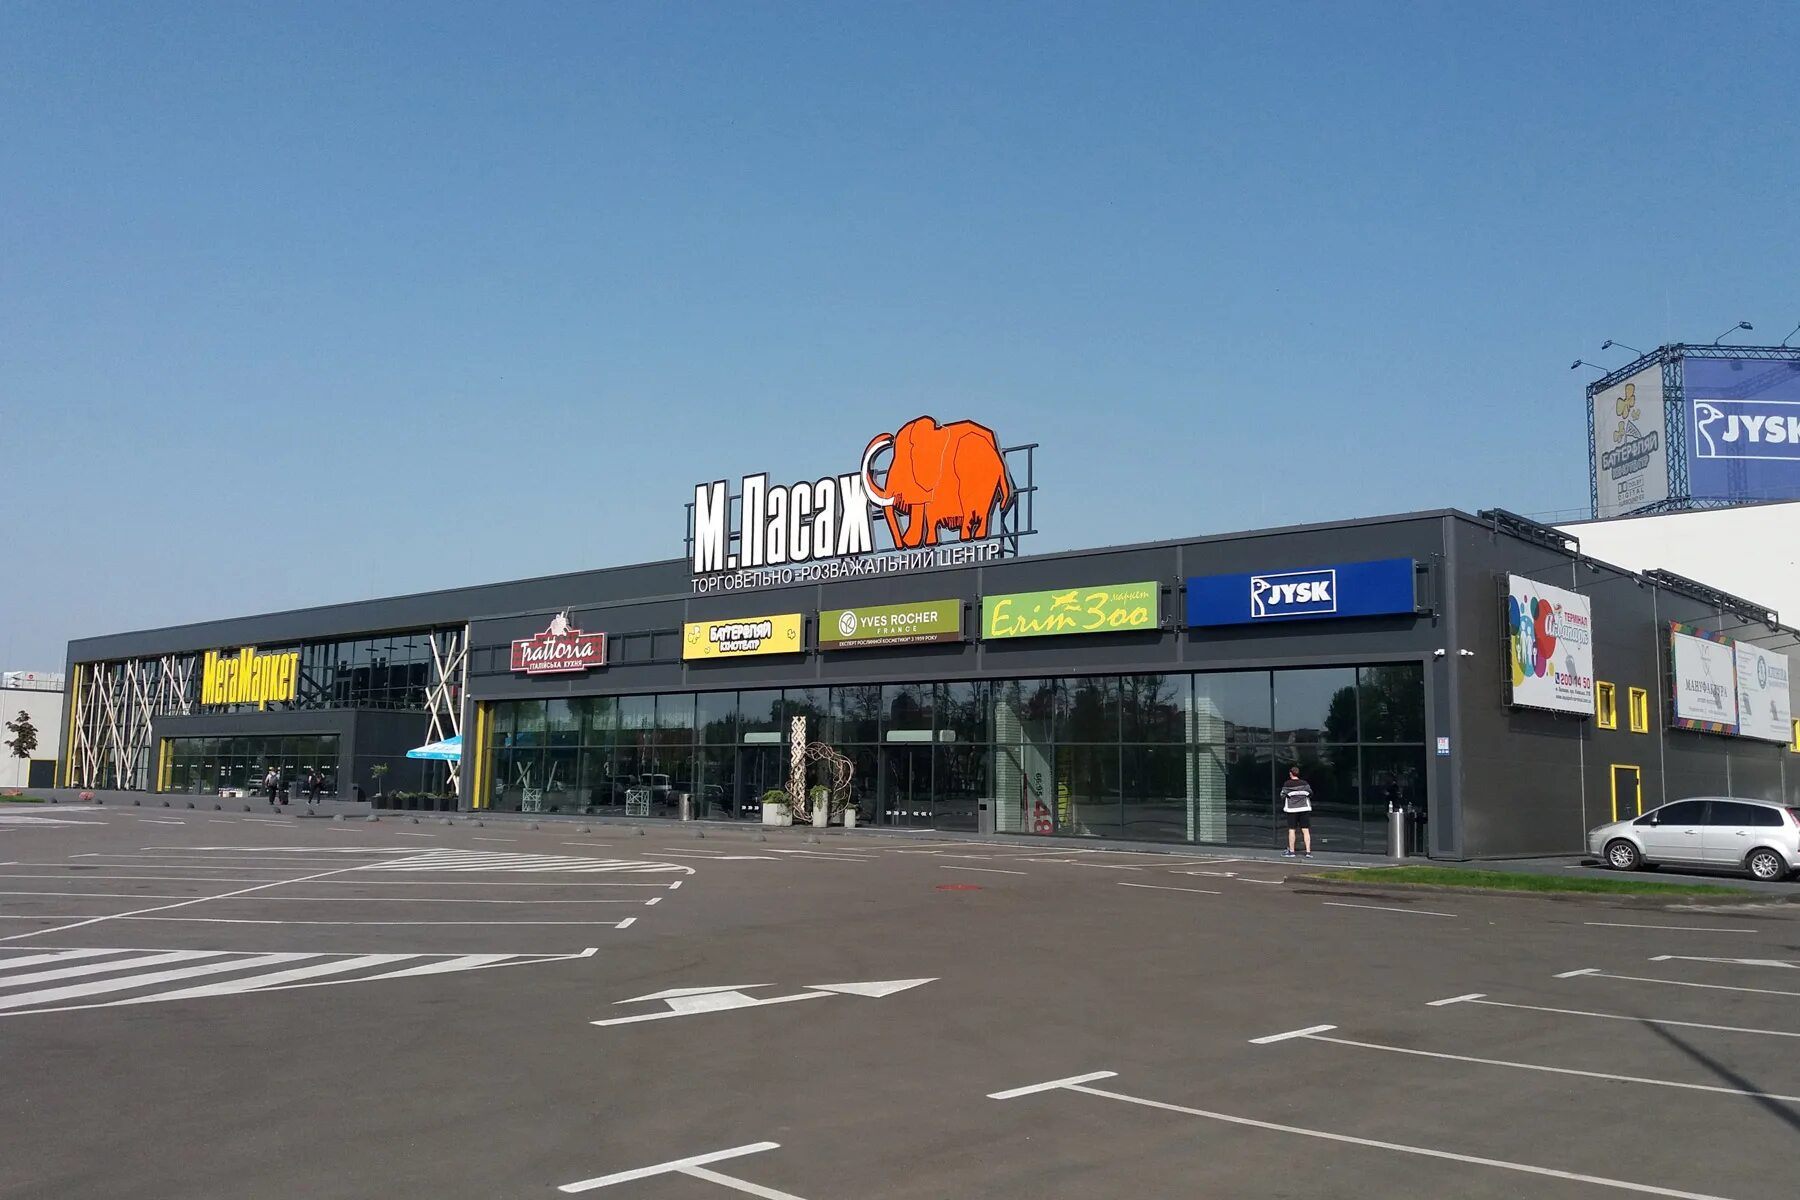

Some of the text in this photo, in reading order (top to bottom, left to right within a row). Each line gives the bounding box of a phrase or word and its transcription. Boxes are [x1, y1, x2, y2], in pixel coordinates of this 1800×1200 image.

[1722, 415, 1800, 443] JYSK
[939, 543, 1001, 567] ЦЕНТР
[1267, 580, 1332, 605] JYSK
[860, 611, 938, 628] YVES ROCHER
[1564, 611, 1588, 626] ТЕРМІНАЛ
[709, 620, 772, 642] БАТТЕРФЛЯЙ
[877, 625, 917, 634] FRANCE
[520, 636, 594, 667] Trattoria
[719, 639, 761, 652] КІНОТЕАТР
[529, 659, 583, 670] ІТАЛІЙСЬКА КУХНЯ
[201, 647, 299, 712] МегаМаркет
[1560, 673, 1591, 689] 200 14 50
